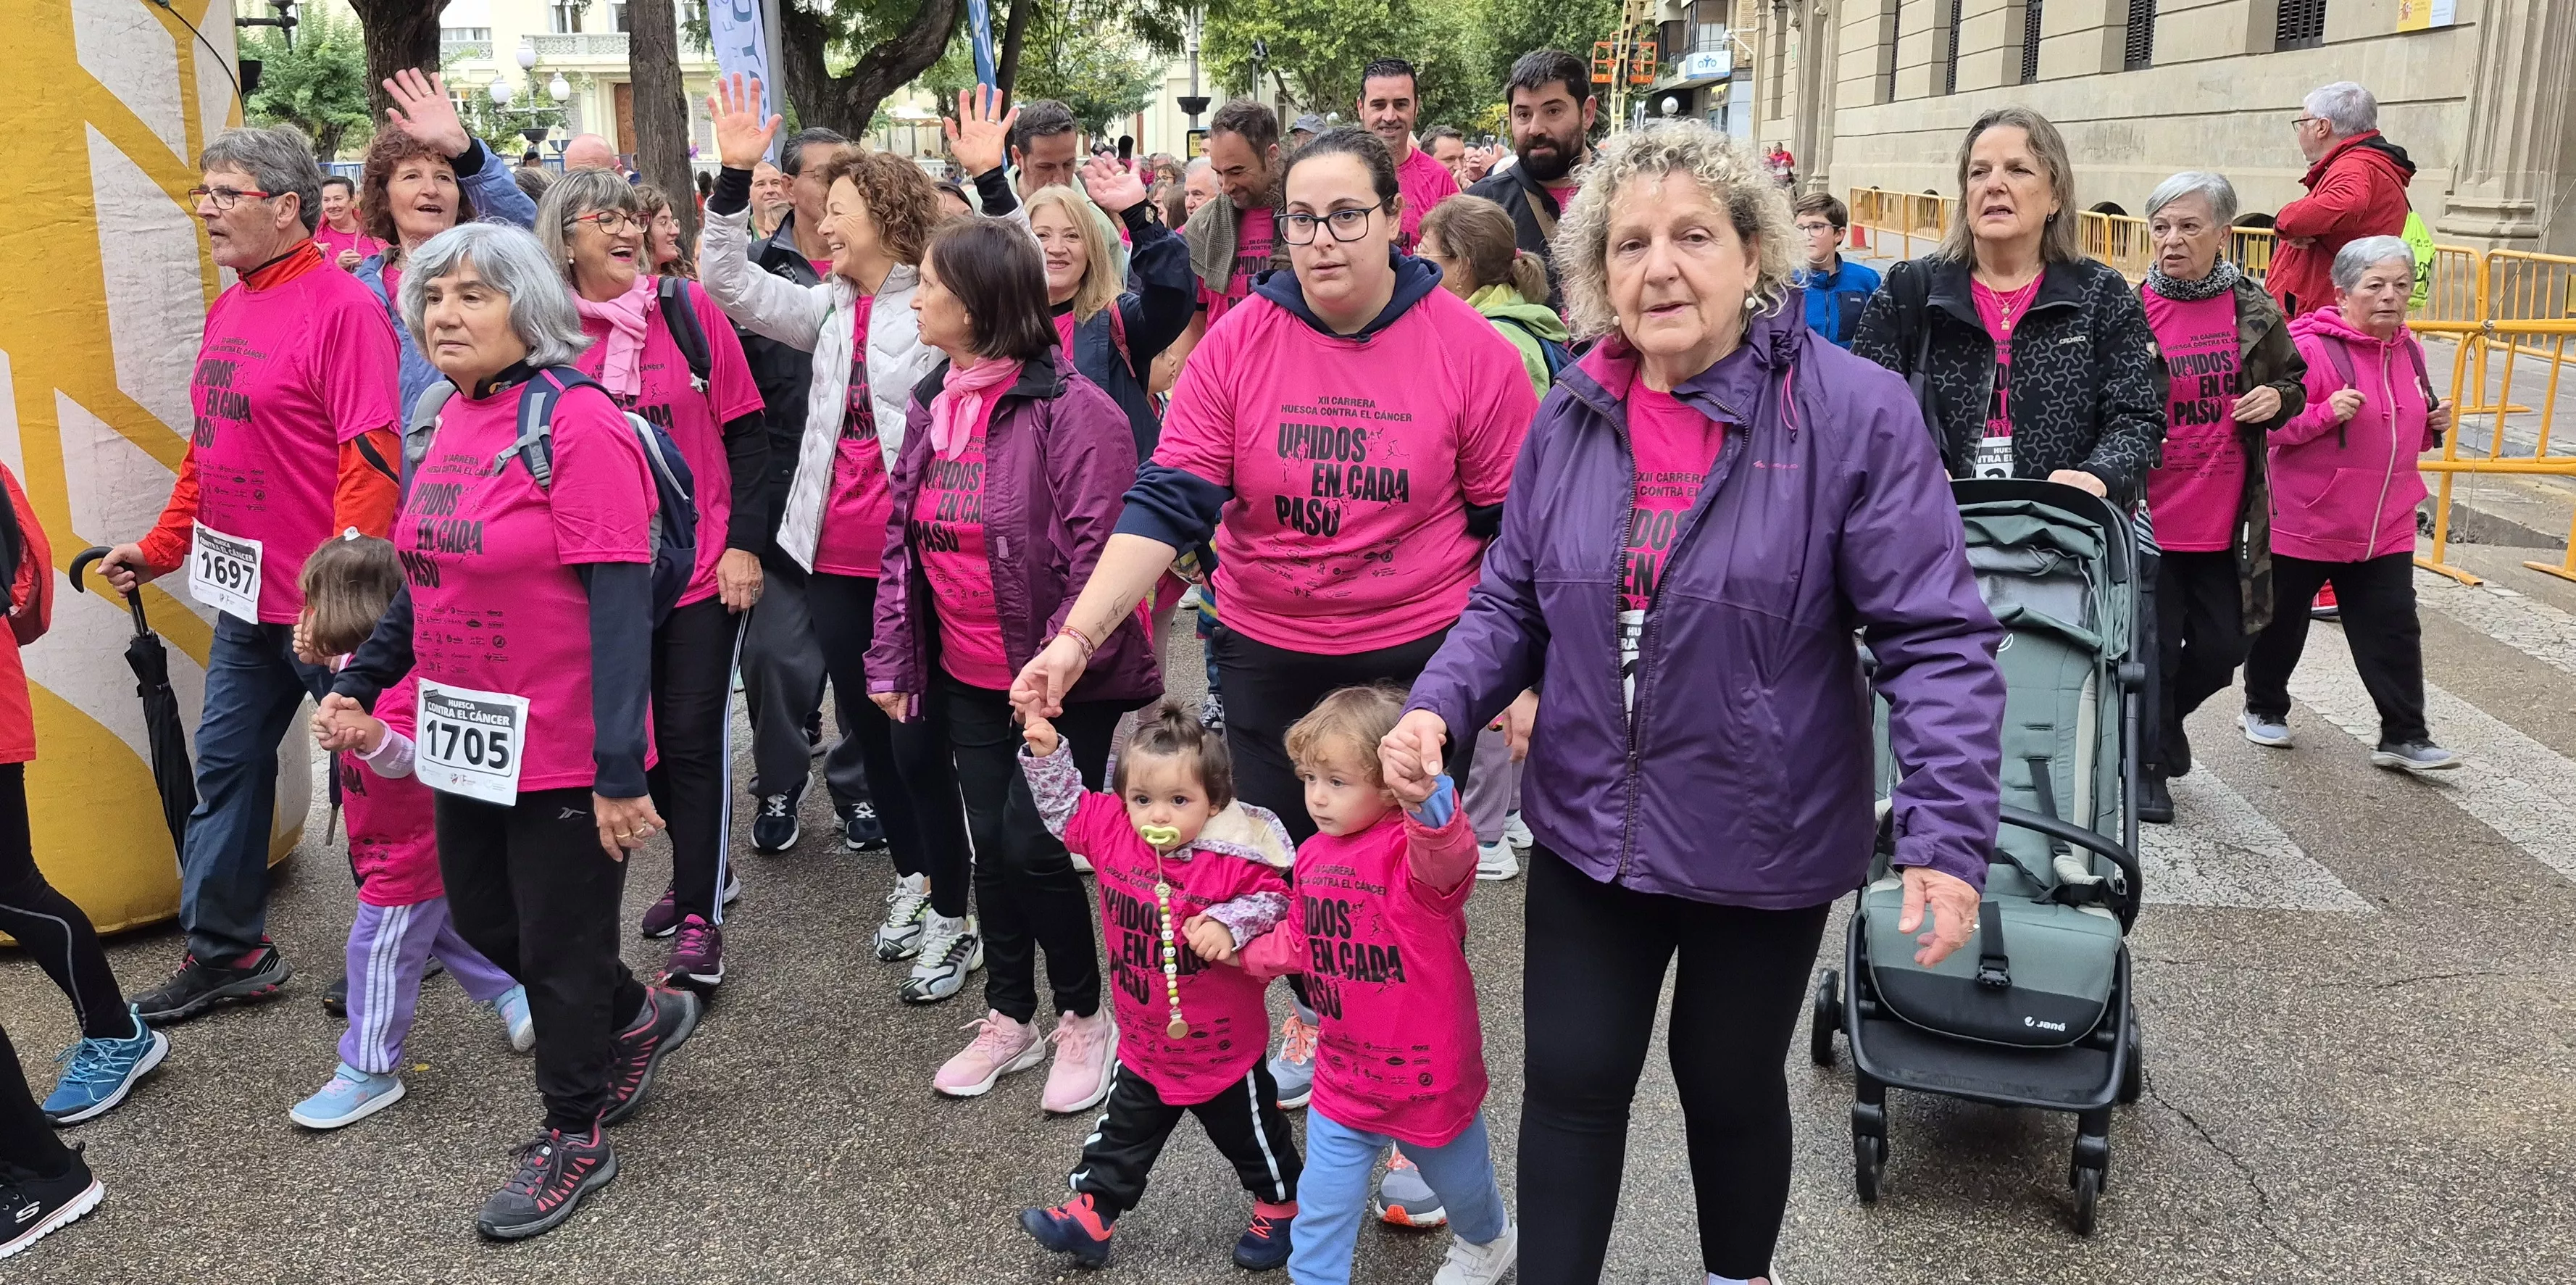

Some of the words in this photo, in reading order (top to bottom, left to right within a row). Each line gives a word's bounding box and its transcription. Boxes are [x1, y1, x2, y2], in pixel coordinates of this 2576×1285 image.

[2169, 349, 2233, 378] UNIDOS
[2199, 375, 2220, 399] EN
[1280, 404, 1318, 415] HUESCA
[1320, 409, 1358, 417] CONTRA
[1359, 409, 1372, 419] EL
[1374, 410, 1413, 423] CÁNCER
[1317, 396, 1329, 405] XII
[1331, 396, 1376, 409] CARRERA
[2173, 397, 2223, 426] PASO
[1277, 423, 1367, 463] UNIDOS
[1311, 462, 1343, 498] EN
[1346, 465, 1410, 504] CADA
[1637, 473, 1653, 483] XII
[1640, 486, 1684, 497] CONTRA
[1274, 494, 1341, 538] PASO
[436, 519, 485, 555] CADA
[912, 520, 960, 553] PASO
[201, 550, 255, 595] 1697
[428, 701, 456, 719] CONTRA
[457, 710, 468, 720] EL
[470, 710, 510, 725] CÁNCER
[448, 699, 475, 710] HUESCA
[426, 719, 510, 770] 1705
[1341, 878, 1352, 889] EL
[1123, 931, 1155, 968] EN
[1310, 938, 1339, 976] EN
[1340, 941, 1407, 984] CADA
